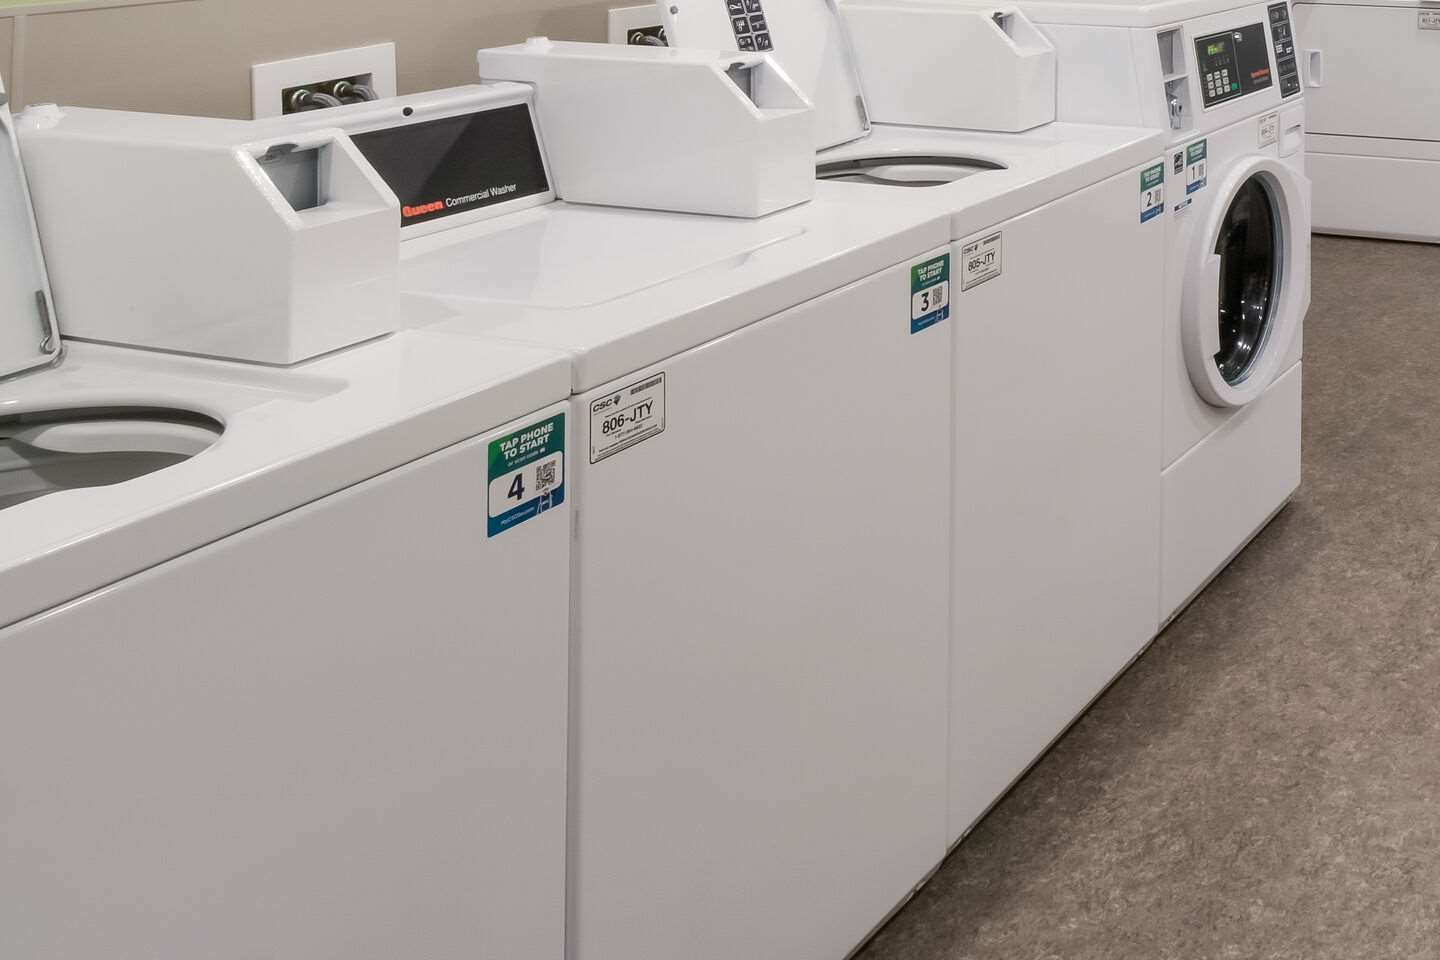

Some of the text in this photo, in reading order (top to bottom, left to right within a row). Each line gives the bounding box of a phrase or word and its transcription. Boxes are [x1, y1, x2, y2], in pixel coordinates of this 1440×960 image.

[402, 183, 517, 217] Queen Commercial Washer
[1146, 191, 1152, 207] 2
[921, 291, 929, 312] 3
[592, 399, 613, 412] CSC
[602, 400, 654, 434] 806-JTY
[499, 422, 554, 451] TAP PHONE
[503, 448, 517, 460] TO
[519, 433, 550, 454] START
[507, 472, 525, 500] 4
